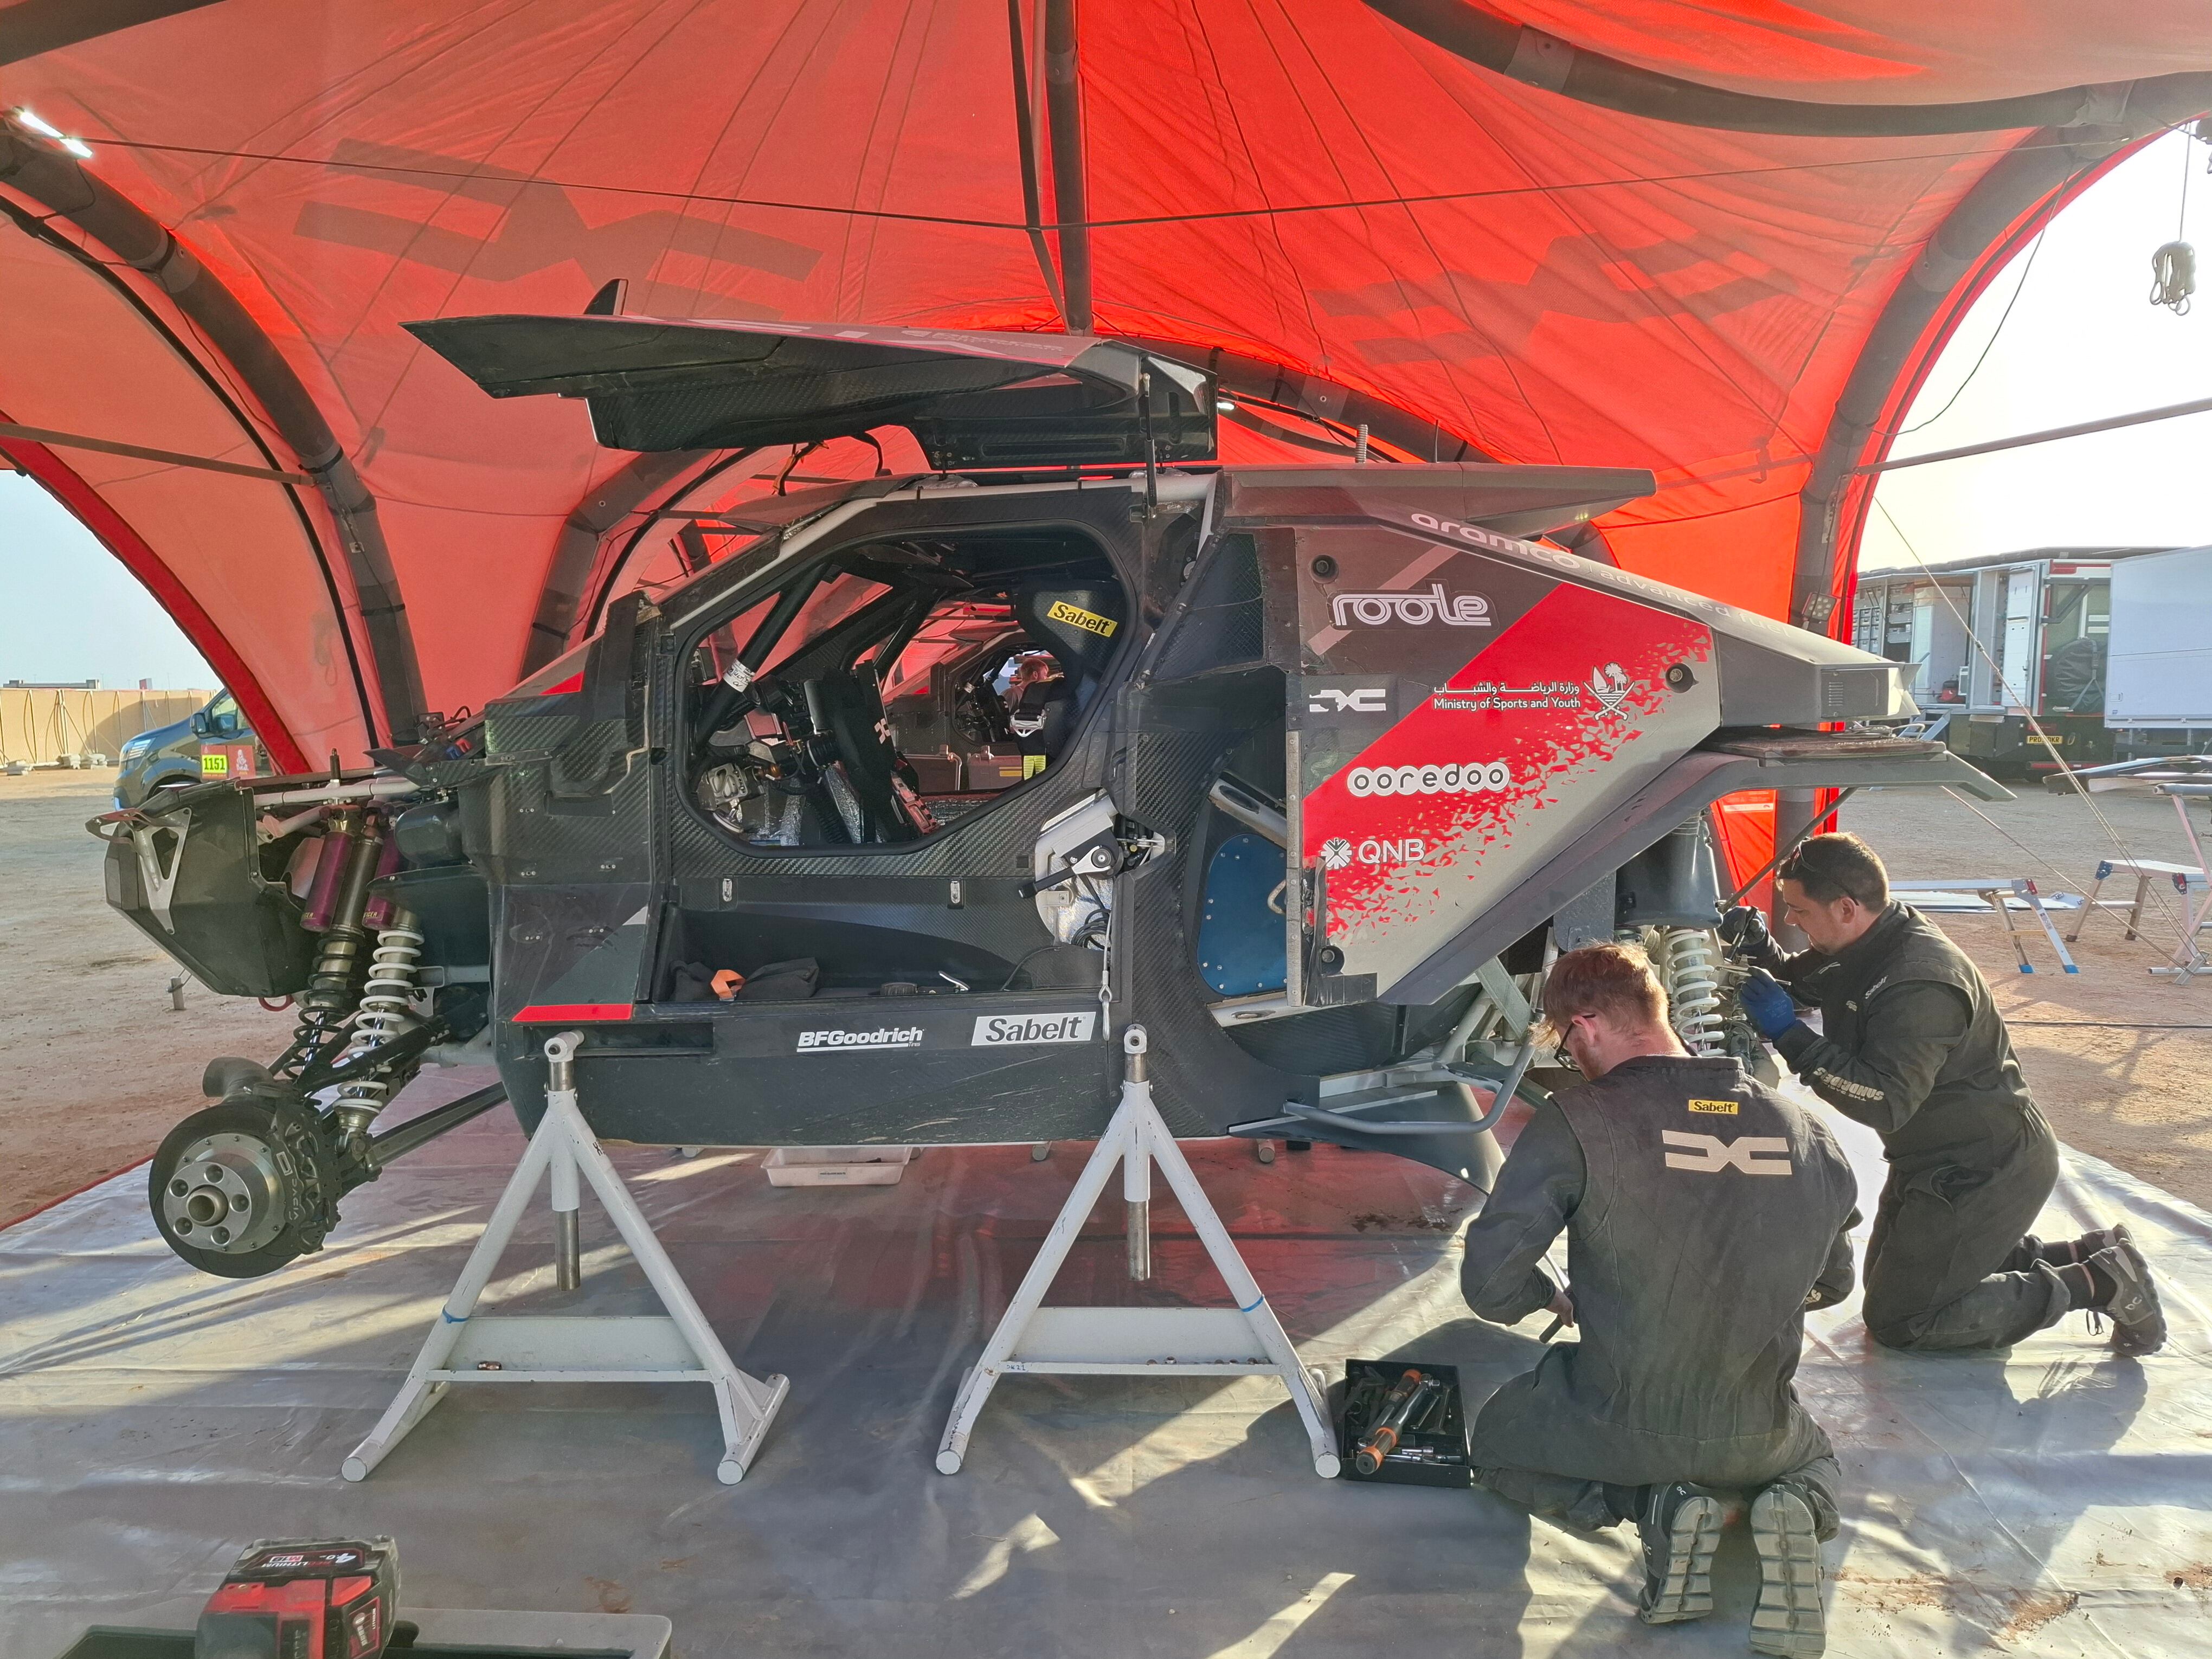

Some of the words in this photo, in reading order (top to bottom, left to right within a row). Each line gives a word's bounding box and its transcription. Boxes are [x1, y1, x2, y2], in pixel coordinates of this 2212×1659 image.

[1411, 513, 1580, 569] aramco
[1600, 570, 1732, 618] advanced
[1052, 605, 1110, 634] Sabelt
[1559, 682, 1580, 695] وزارة
[1434, 698, 1477, 711] Ministry
[1480, 697, 1491, 709] of
[1493, 697, 1528, 710] Sports
[1530, 697, 1548, 708] and
[1551, 697, 1581, 708] Youth
[203, 757, 226, 770] 1151
[1353, 763, 1504, 790] ooredoo
[1357, 839, 1425, 864] QNB
[798, 1026, 923, 1047] BFGoodrich
[985, 1015, 1083, 1042] Sabelt
[1694, 1101, 1734, 1113] Sabelt
